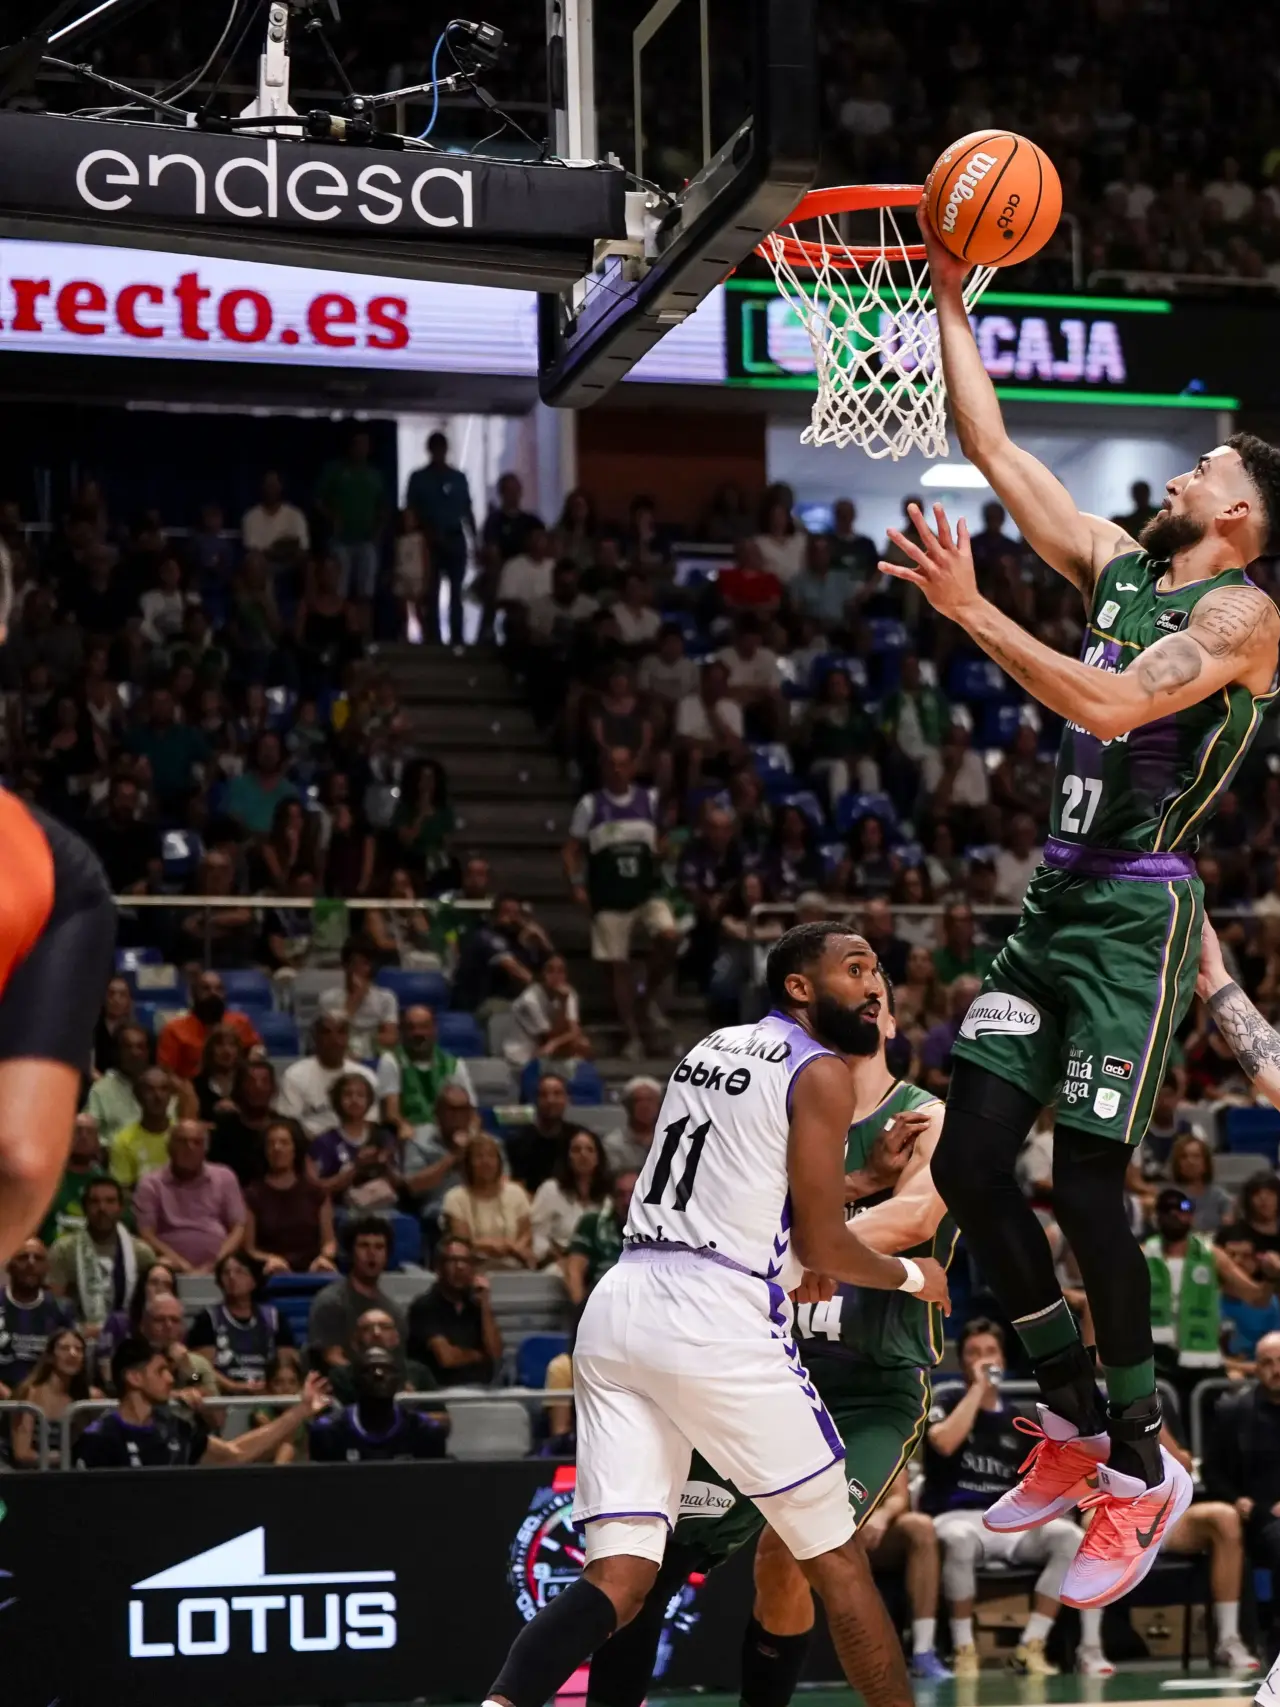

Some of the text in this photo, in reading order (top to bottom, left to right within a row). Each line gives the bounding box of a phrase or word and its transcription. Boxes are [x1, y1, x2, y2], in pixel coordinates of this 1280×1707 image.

[76, 140, 473, 228] endesa
[942, 152, 998, 233] Wilson
[996, 193, 1021, 229] acb
[0, 271, 411, 350] recto.es
[1060, 774, 1103, 834] 27
[1105, 1064, 1125, 1076] acb
[643, 1115, 712, 1213] 11
[798, 1295, 844, 1342] 14
[129, 1591, 397, 1658] LOTUS
